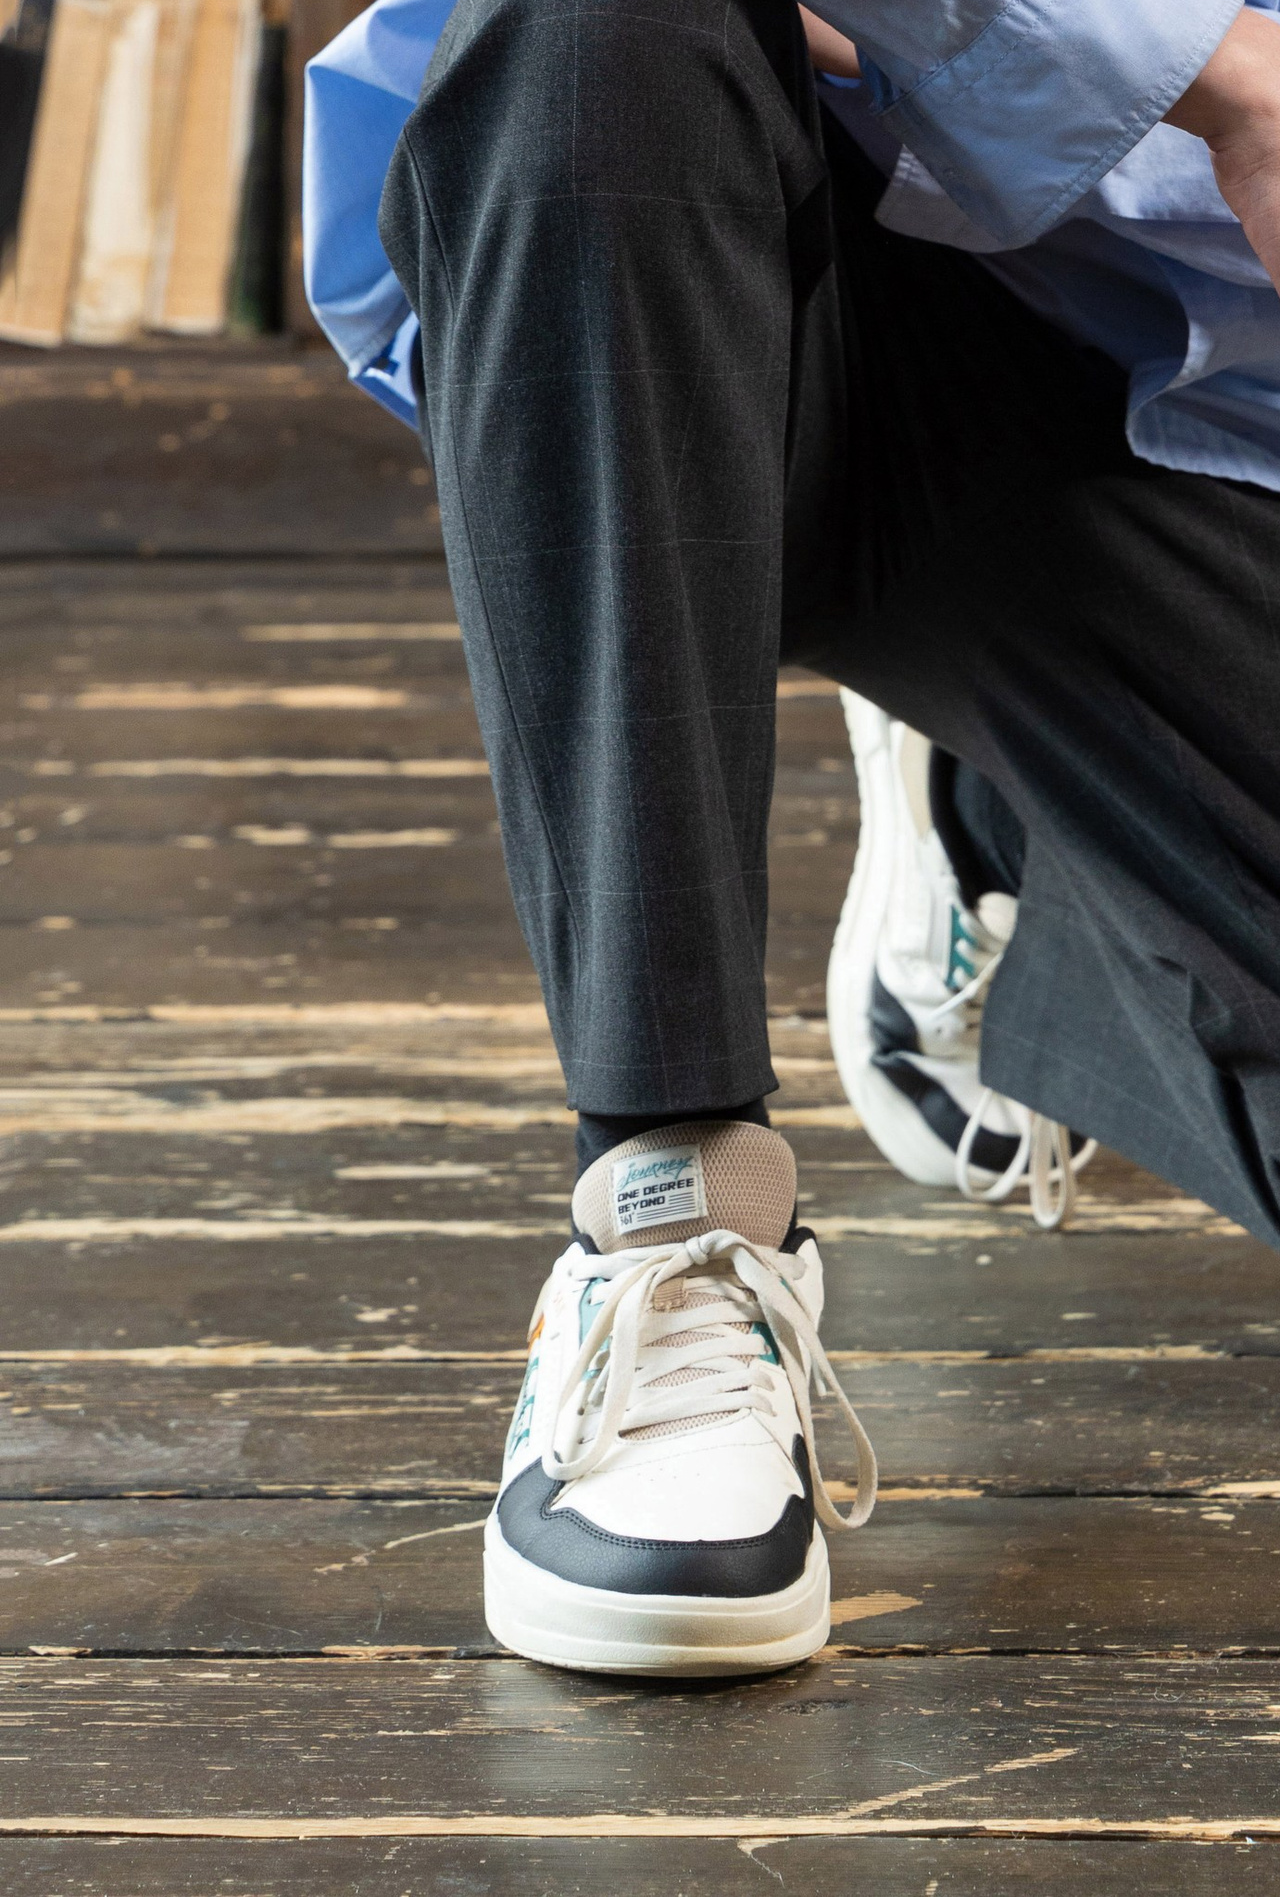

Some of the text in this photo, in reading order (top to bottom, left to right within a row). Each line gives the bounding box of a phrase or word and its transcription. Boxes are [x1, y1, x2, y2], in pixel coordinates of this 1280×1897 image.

[618, 1178, 694, 1202] ONE DEGREE
[618, 1196, 665, 1214] BEYOND
